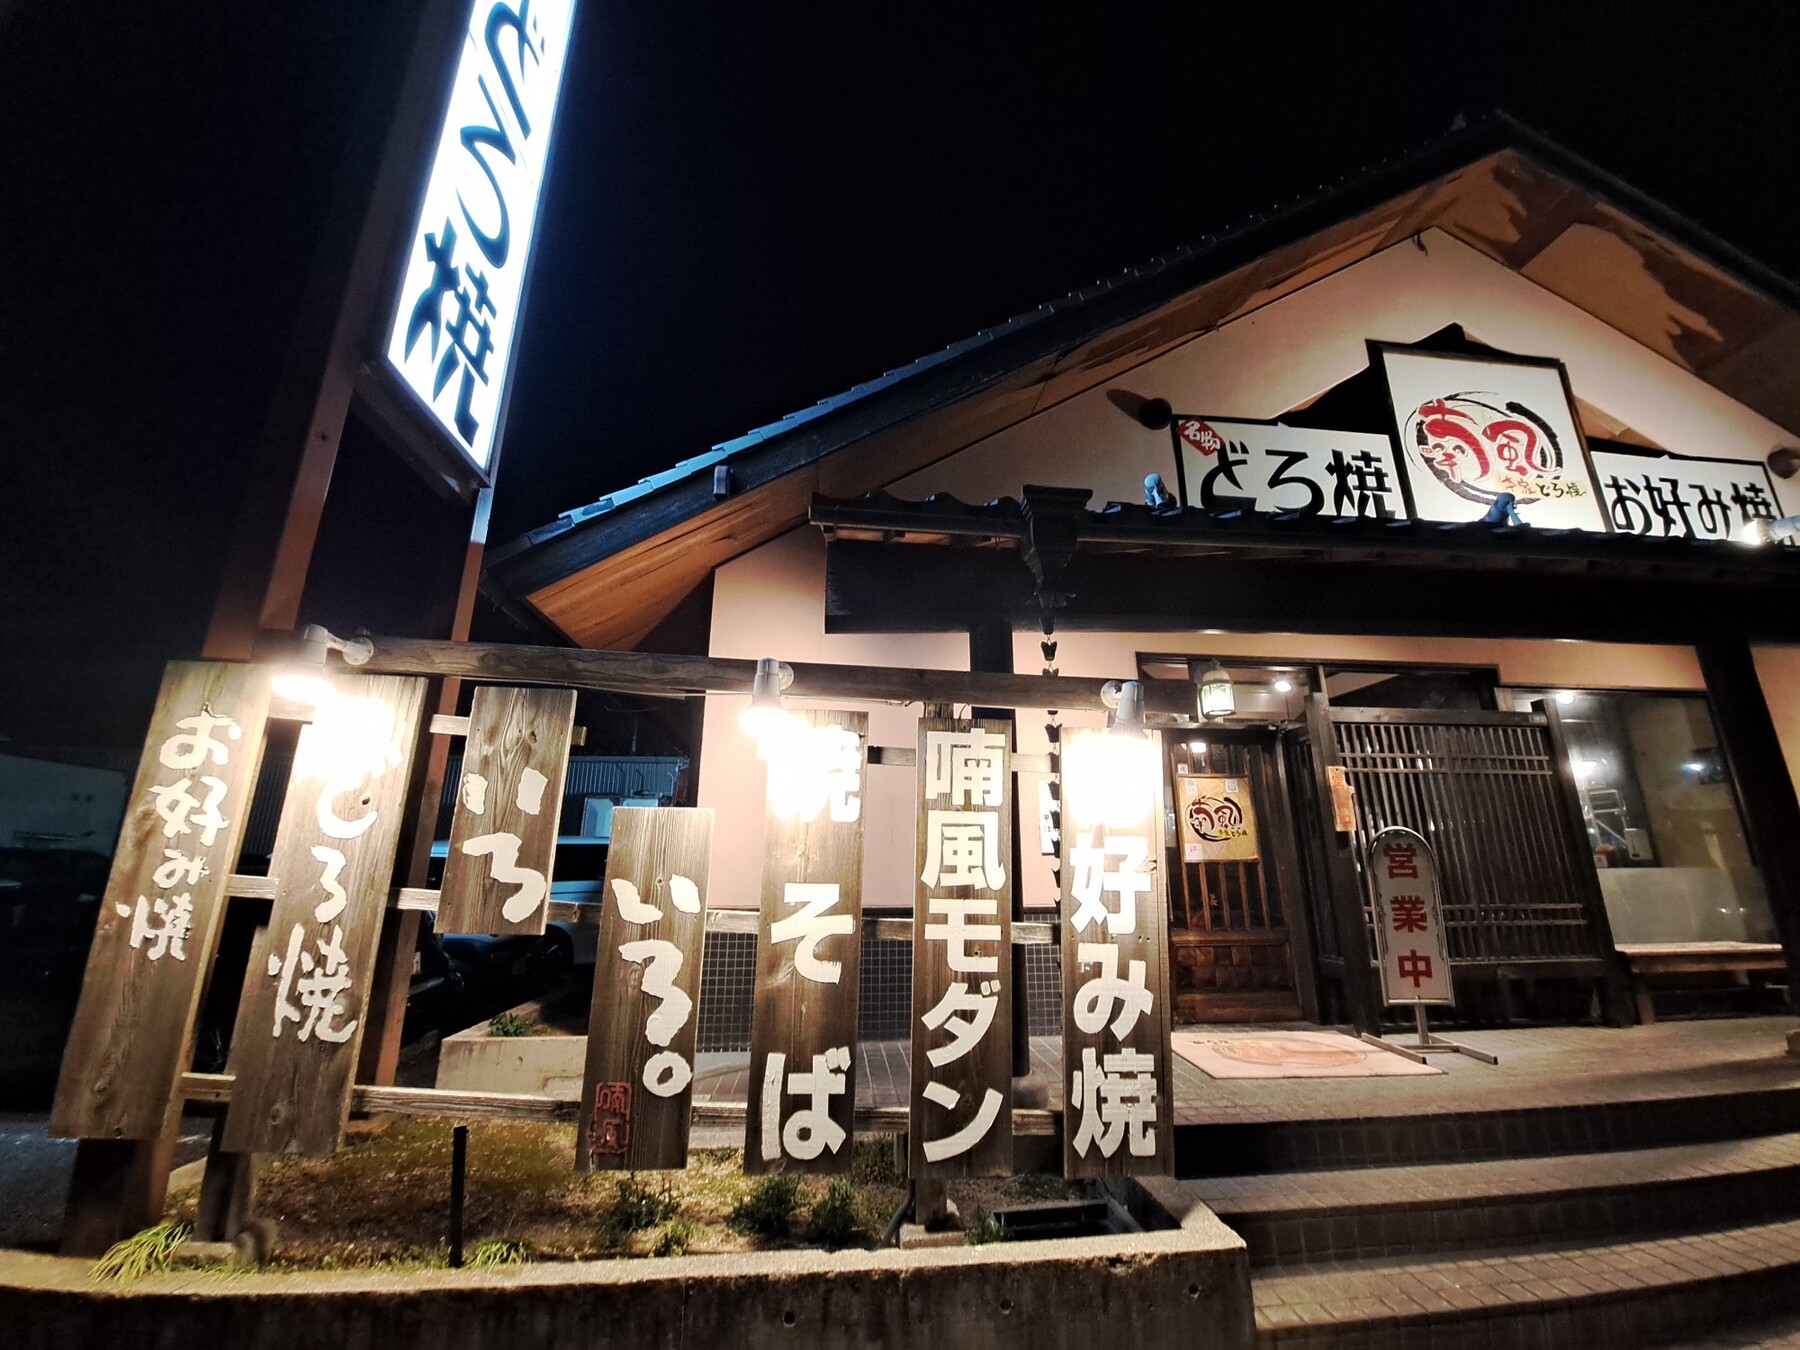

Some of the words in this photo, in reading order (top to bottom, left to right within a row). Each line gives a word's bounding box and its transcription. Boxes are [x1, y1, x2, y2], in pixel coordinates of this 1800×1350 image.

[1201, 440, 1397, 519] どろ焼
[461, 767, 547, 923] いろ
[1382, 842, 1432, 988] 営業中
[921, 728, 1006, 1162] 喃風モダン
[1069, 750, 1153, 1160] 好み焼
